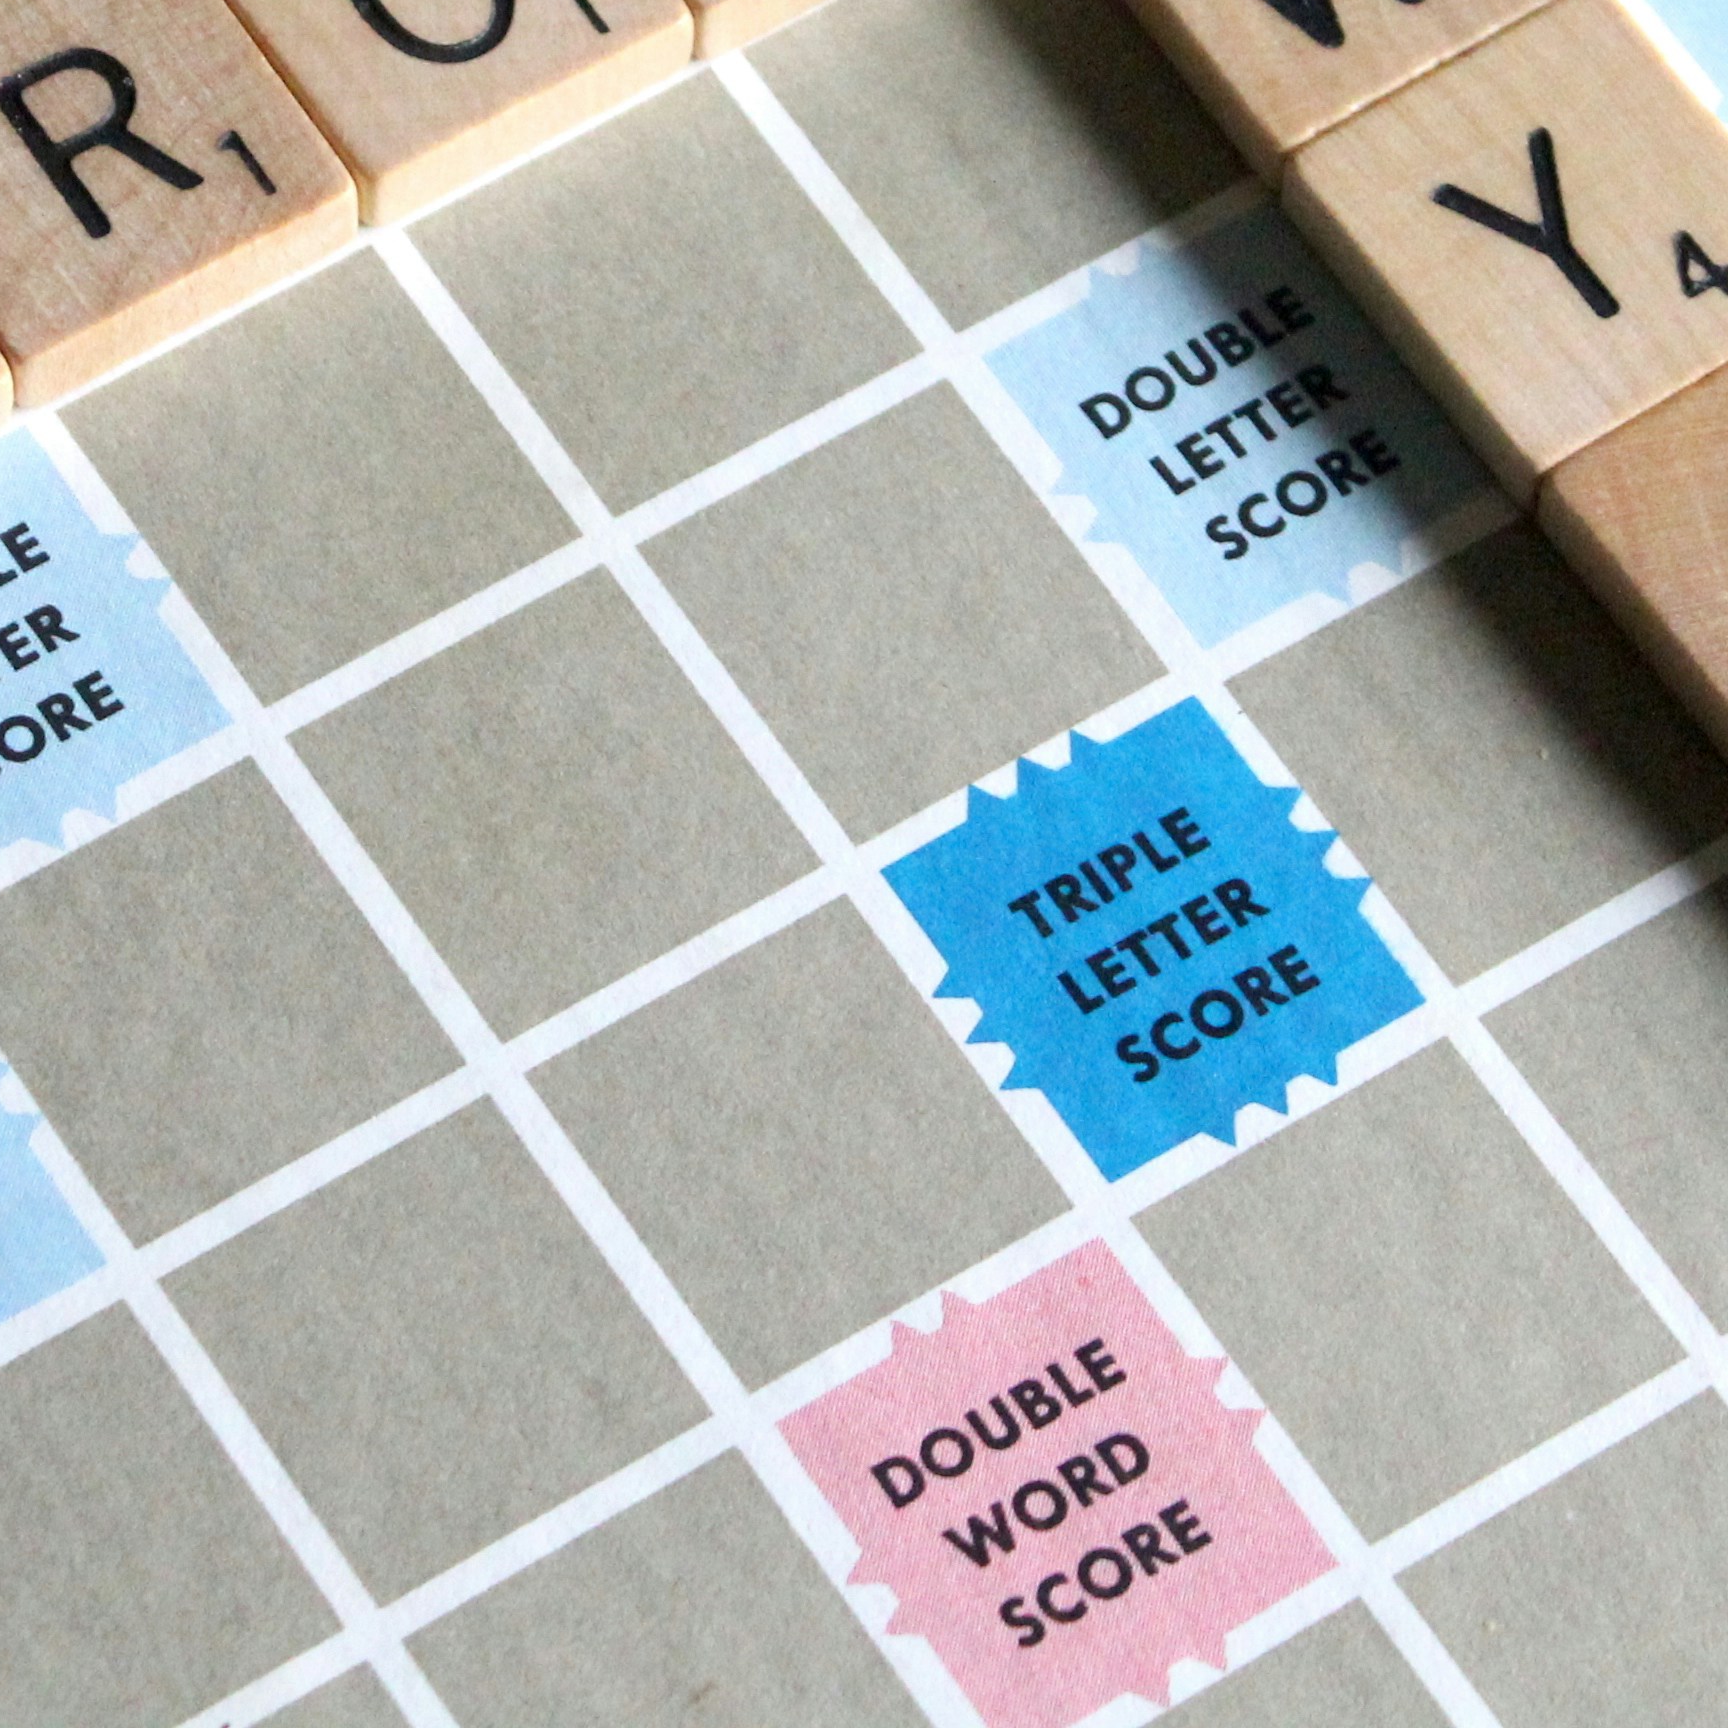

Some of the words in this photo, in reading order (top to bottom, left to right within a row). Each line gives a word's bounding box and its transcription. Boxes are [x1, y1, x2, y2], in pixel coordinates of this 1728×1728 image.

[216, 128, 278, 197] 1
[1430, 126, 1622, 320] Y
[1078, 283, 1317, 441] DOUBLE
[1148, 362, 1353, 497] LETTER
[1204, 426, 1403, 562] SCORE
[1007, 806, 1212, 940] TRIPLE
[1057, 877, 1271, 1016] LETTER
[1115, 944, 1322, 1084] SCORE
[869, 1337, 1128, 1510] DOUBLE
[941, 1432, 1151, 1569] WORD
[998, 1498, 1213, 1648] SCORE
